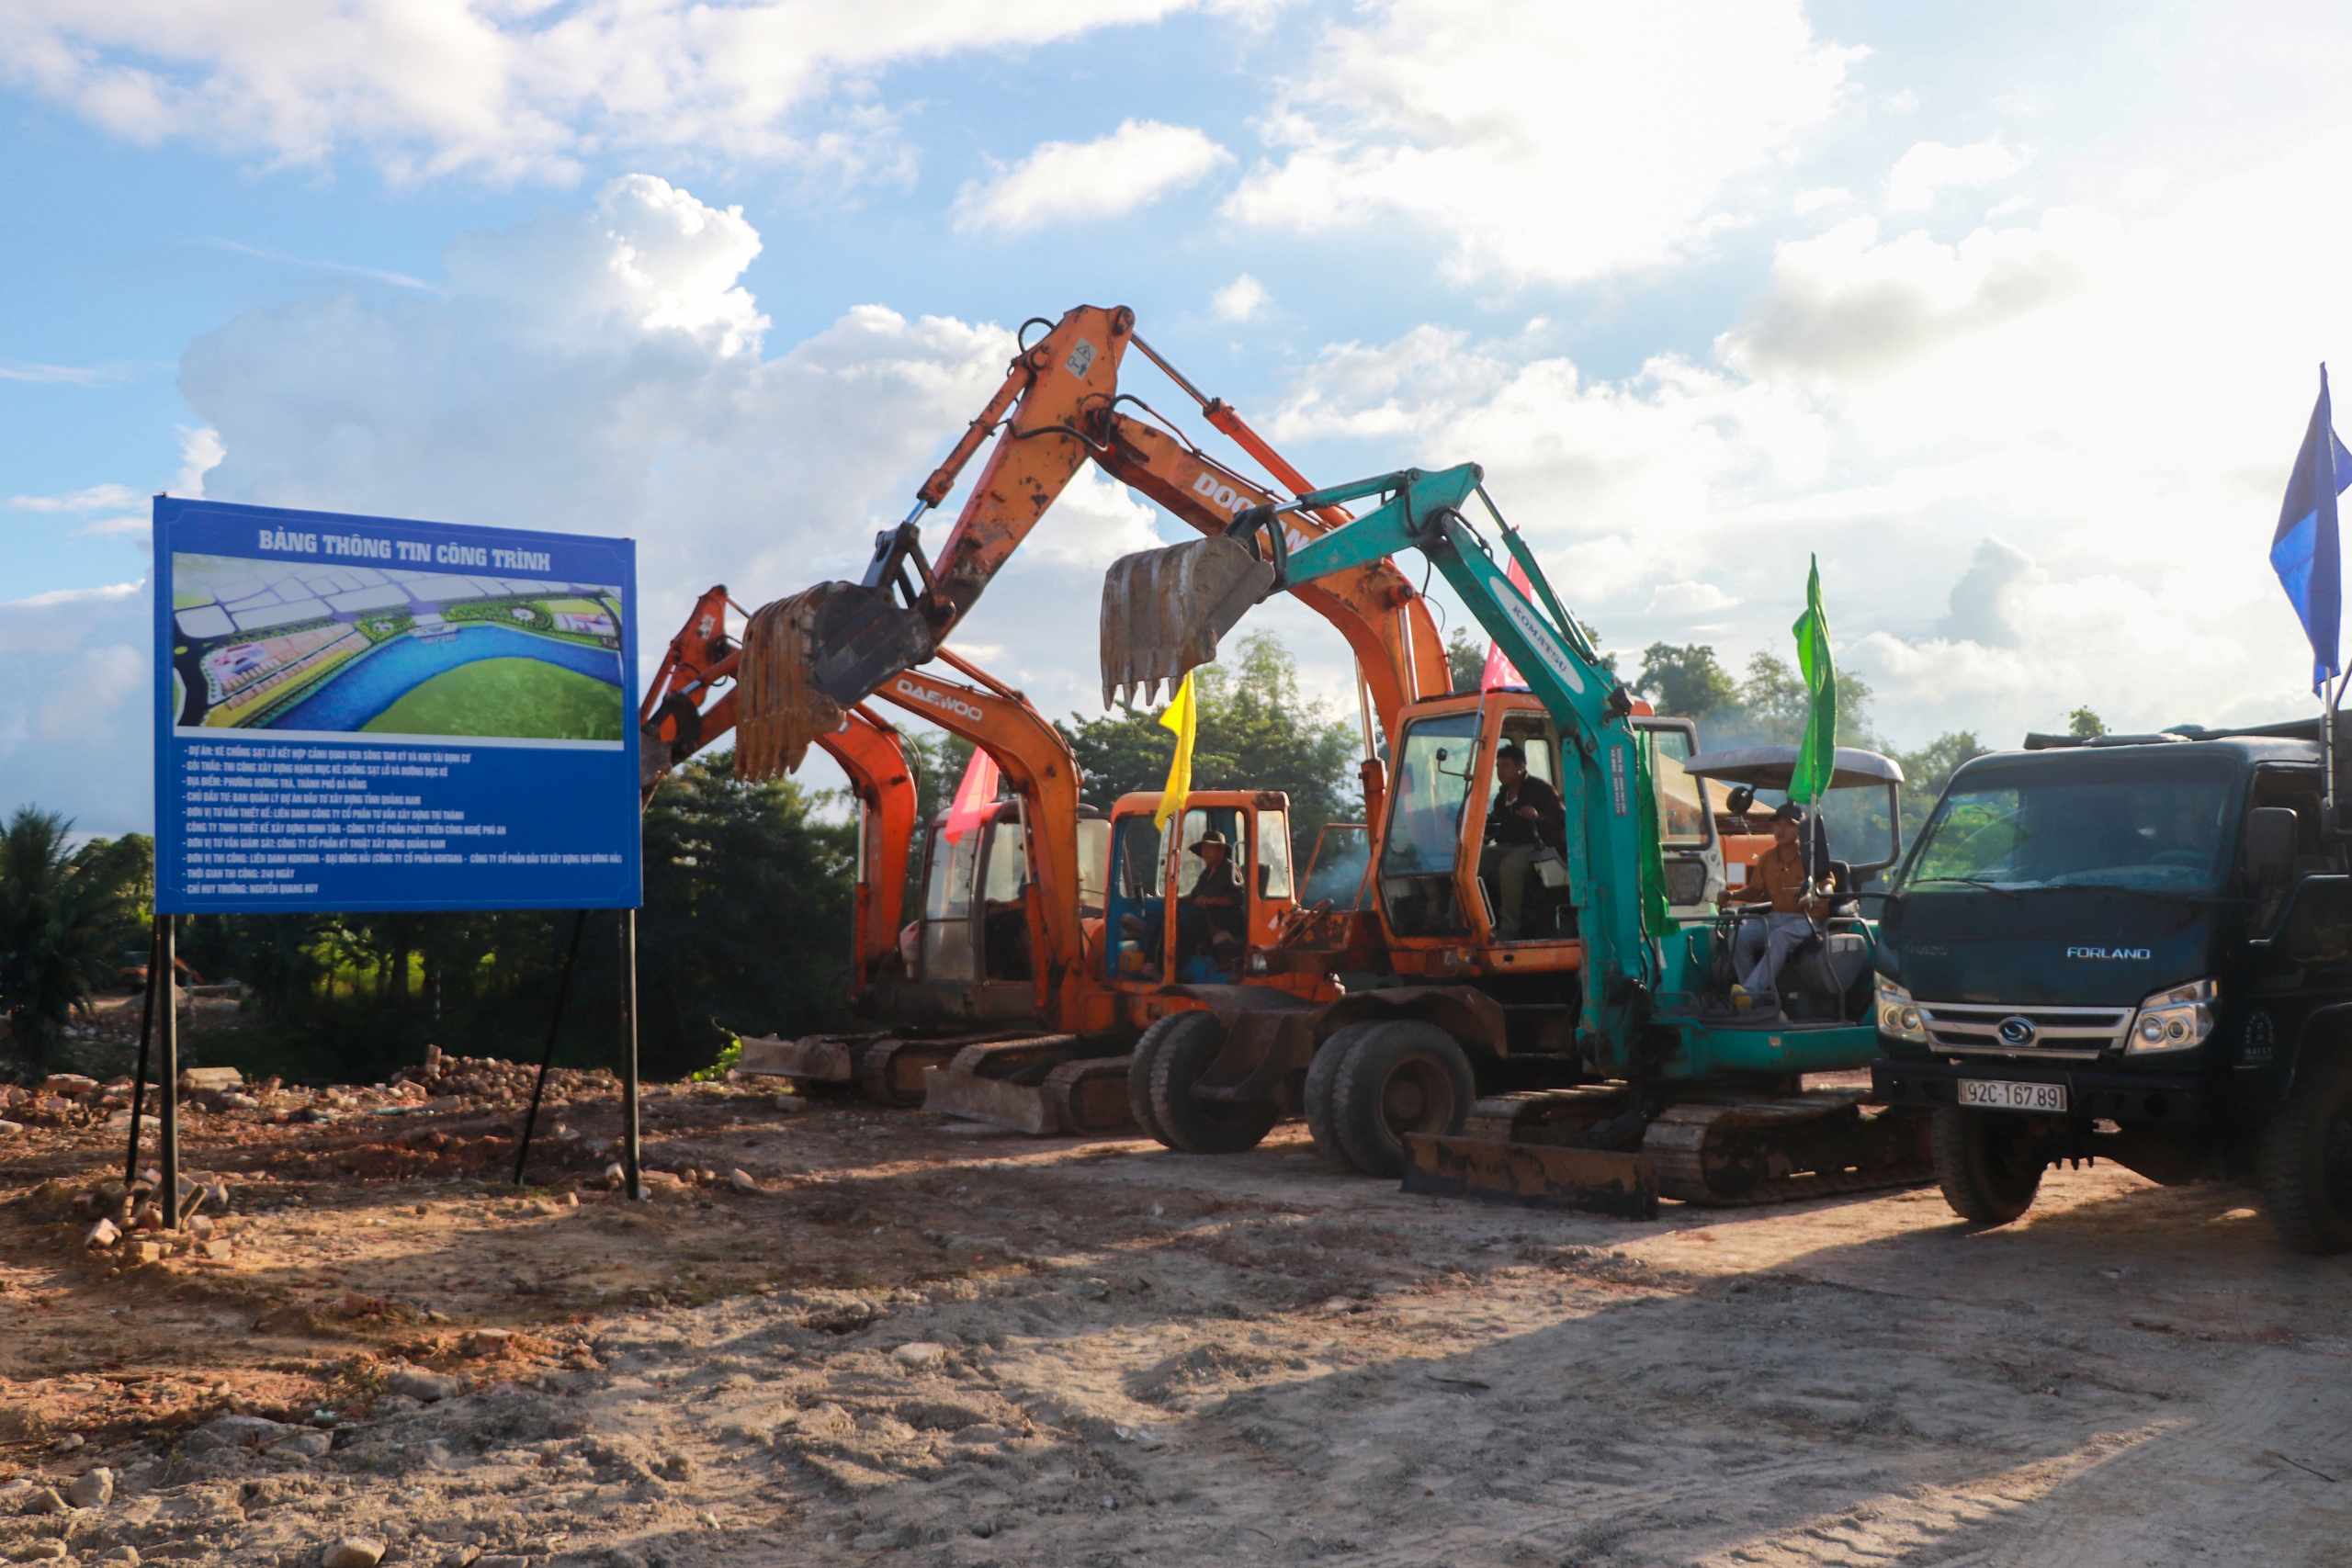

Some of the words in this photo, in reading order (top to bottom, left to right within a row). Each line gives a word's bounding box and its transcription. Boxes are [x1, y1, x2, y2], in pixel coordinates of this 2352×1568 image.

[259, 526, 317, 552] BẢNG
[322, 534, 391, 558] THÔNG
[396, 541, 431, 561] TIN
[436, 542, 487, 566] CÔNG
[492, 547, 550, 570] TRÌNH
[1512, 605, 1567, 671] KOMATSU
[896, 678, 983, 721] DAEWOO
[2066, 946, 2151, 959] FORLAND
[1968, 1083, 2058, 1108] 92C-167.89
